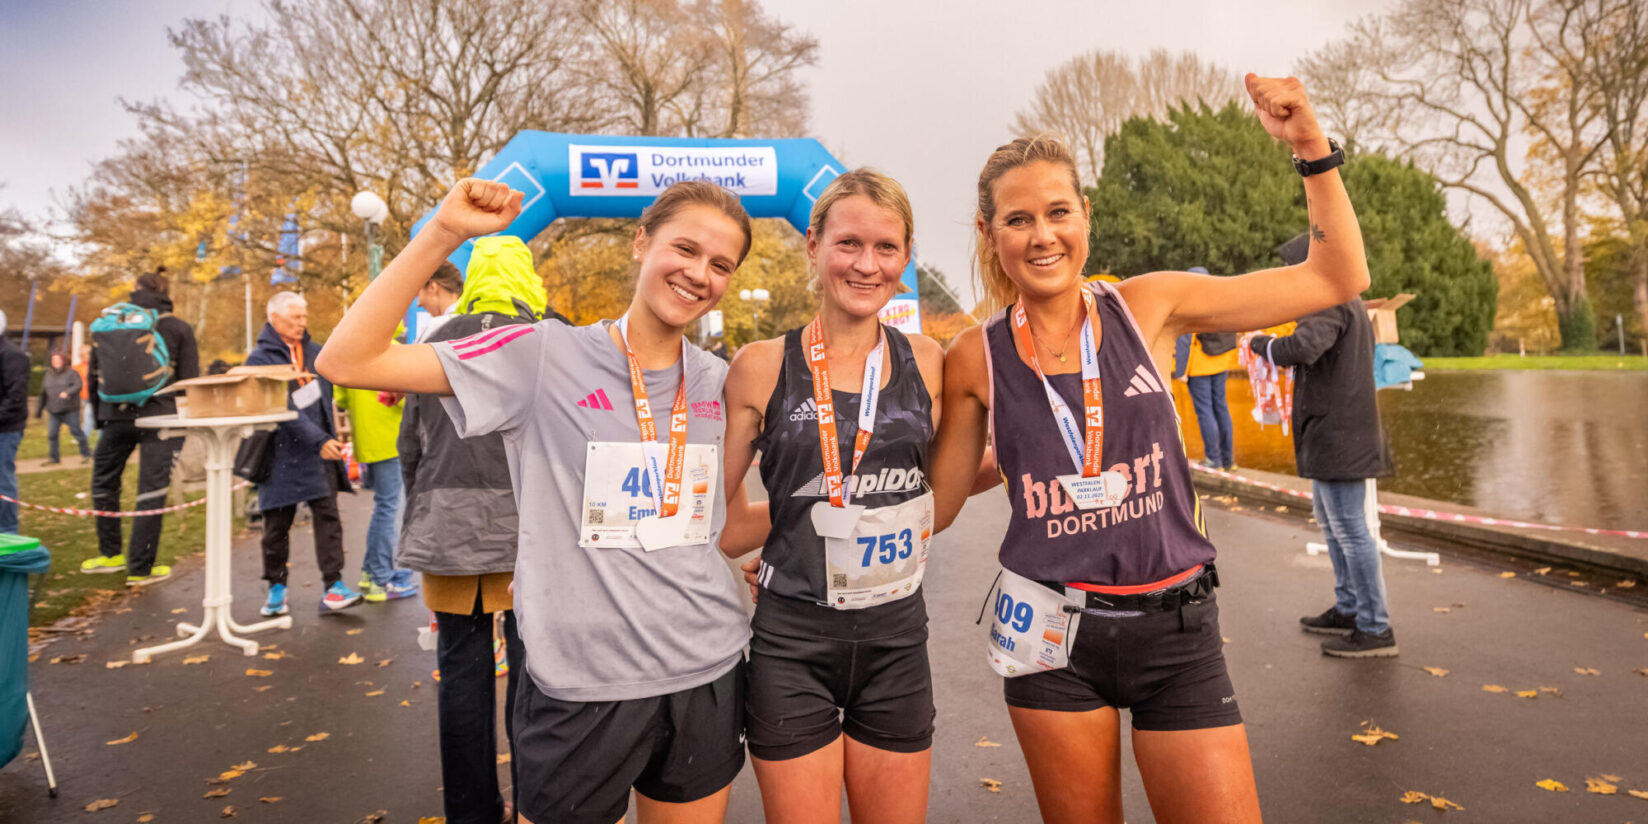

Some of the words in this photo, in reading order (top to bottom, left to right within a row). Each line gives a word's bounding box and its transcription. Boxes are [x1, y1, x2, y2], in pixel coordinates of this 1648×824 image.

[651, 153, 765, 167] Dortmunder
[667, 437, 677, 480] Dortmunder
[674, 445, 684, 480] Volksbank
[821, 430, 832, 473] Dortmunder
[830, 436, 840, 472] Volksbank
[1085, 430, 1094, 467] Volksbank
[1092, 430, 1102, 475] Dortmunder
[1022, 442, 1164, 519] buert
[1047, 491, 1164, 538] DORTMUND
[857, 528, 913, 567] 753
